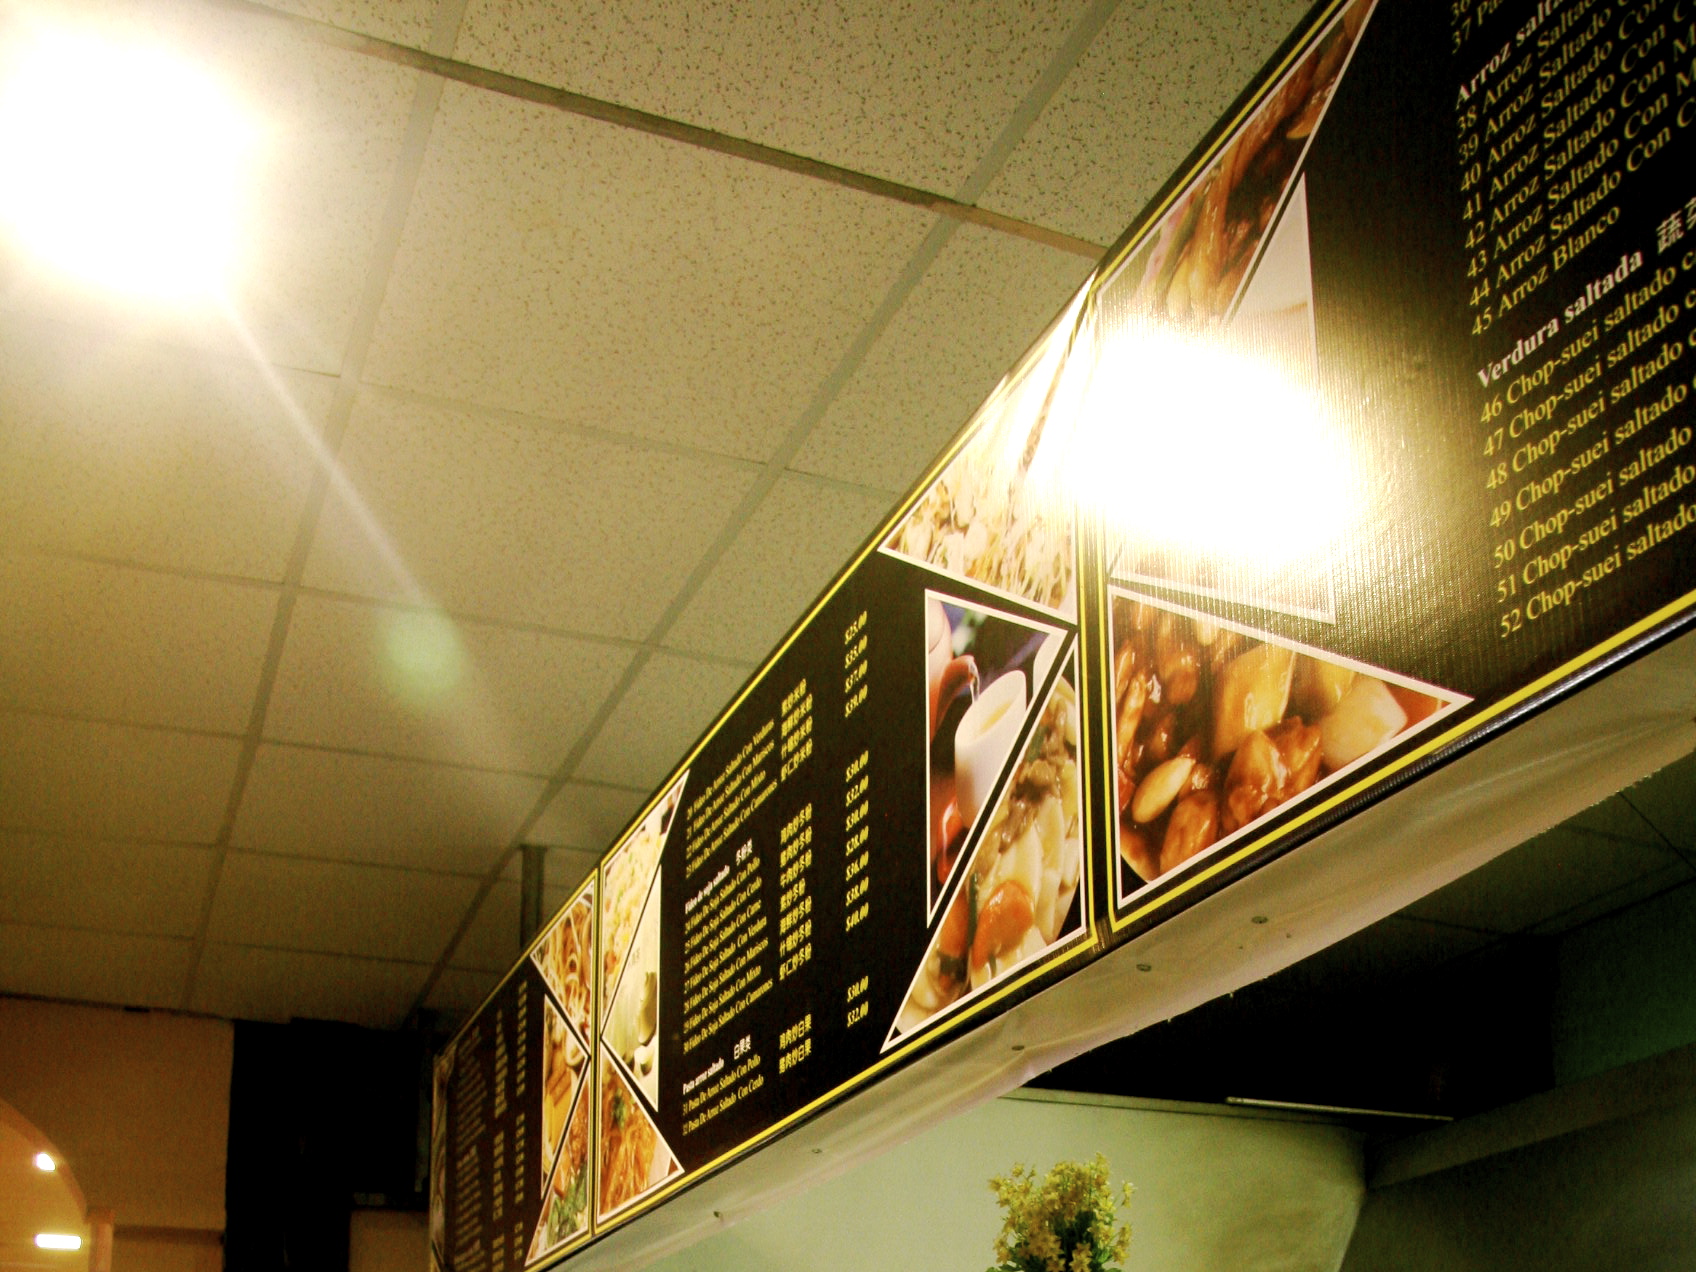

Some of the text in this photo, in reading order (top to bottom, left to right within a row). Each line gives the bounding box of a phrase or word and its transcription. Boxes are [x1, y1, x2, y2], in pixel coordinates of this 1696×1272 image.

[1452, 17, 1471, 54] 37
[1455, 42, 1511, 111] Arroz
[1457, 105, 1477, 139] 38
[1482, 53, 1532, 114] Arroz
[1458, 133, 1479, 166] 39
[1484, 83, 1534, 143] Arroz
[1538, 8, 1612, 89] Saltado
[1460, 162, 1481, 192] 40
[1486, 114, 1536, 172] Arroz
[1540, 41, 1613, 119] Saltado
[1462, 192, 1481, 220] 41
[1489, 144, 1538, 201] Arroz
[1543, 73, 1615, 149] Saltado
[1620, 24, 1665, 74] Con
[1464, 220, 1485, 249] 42
[1489, 175, 1539, 232] Arroz
[1543, 107, 1615, 181] Saltado
[1620, 60, 1665, 109] Con
[1467, 249, 1487, 278] 43
[1493, 204, 1543, 260] Arroz
[1547, 138, 1619, 211] Saltado
[1623, 93, 1668, 140] Con
[1469, 127, 1671, 306] 44 Arroz Saltado Con
[1471, 206, 1620, 335] 45 Arroz Blanco
[1476, 251, 1642, 389] Verdura saltada
[1480, 266, 1676, 424] 46 Chop-suei saltado
[1482, 304, 1679, 457] 47 Chop-suei saltado
[1485, 342, 1683, 490] 48 Chop-suei saltado
[1489, 384, 1687, 528] 49 Chop-suei saltado
[1493, 427, 1692, 569] 50 Chop-suei saltado
[1497, 465, 1696, 603] 51 Chop-suei saltado
[1500, 608, 1522, 638] 52
[1525, 545, 1622, 620] Chop-suei
